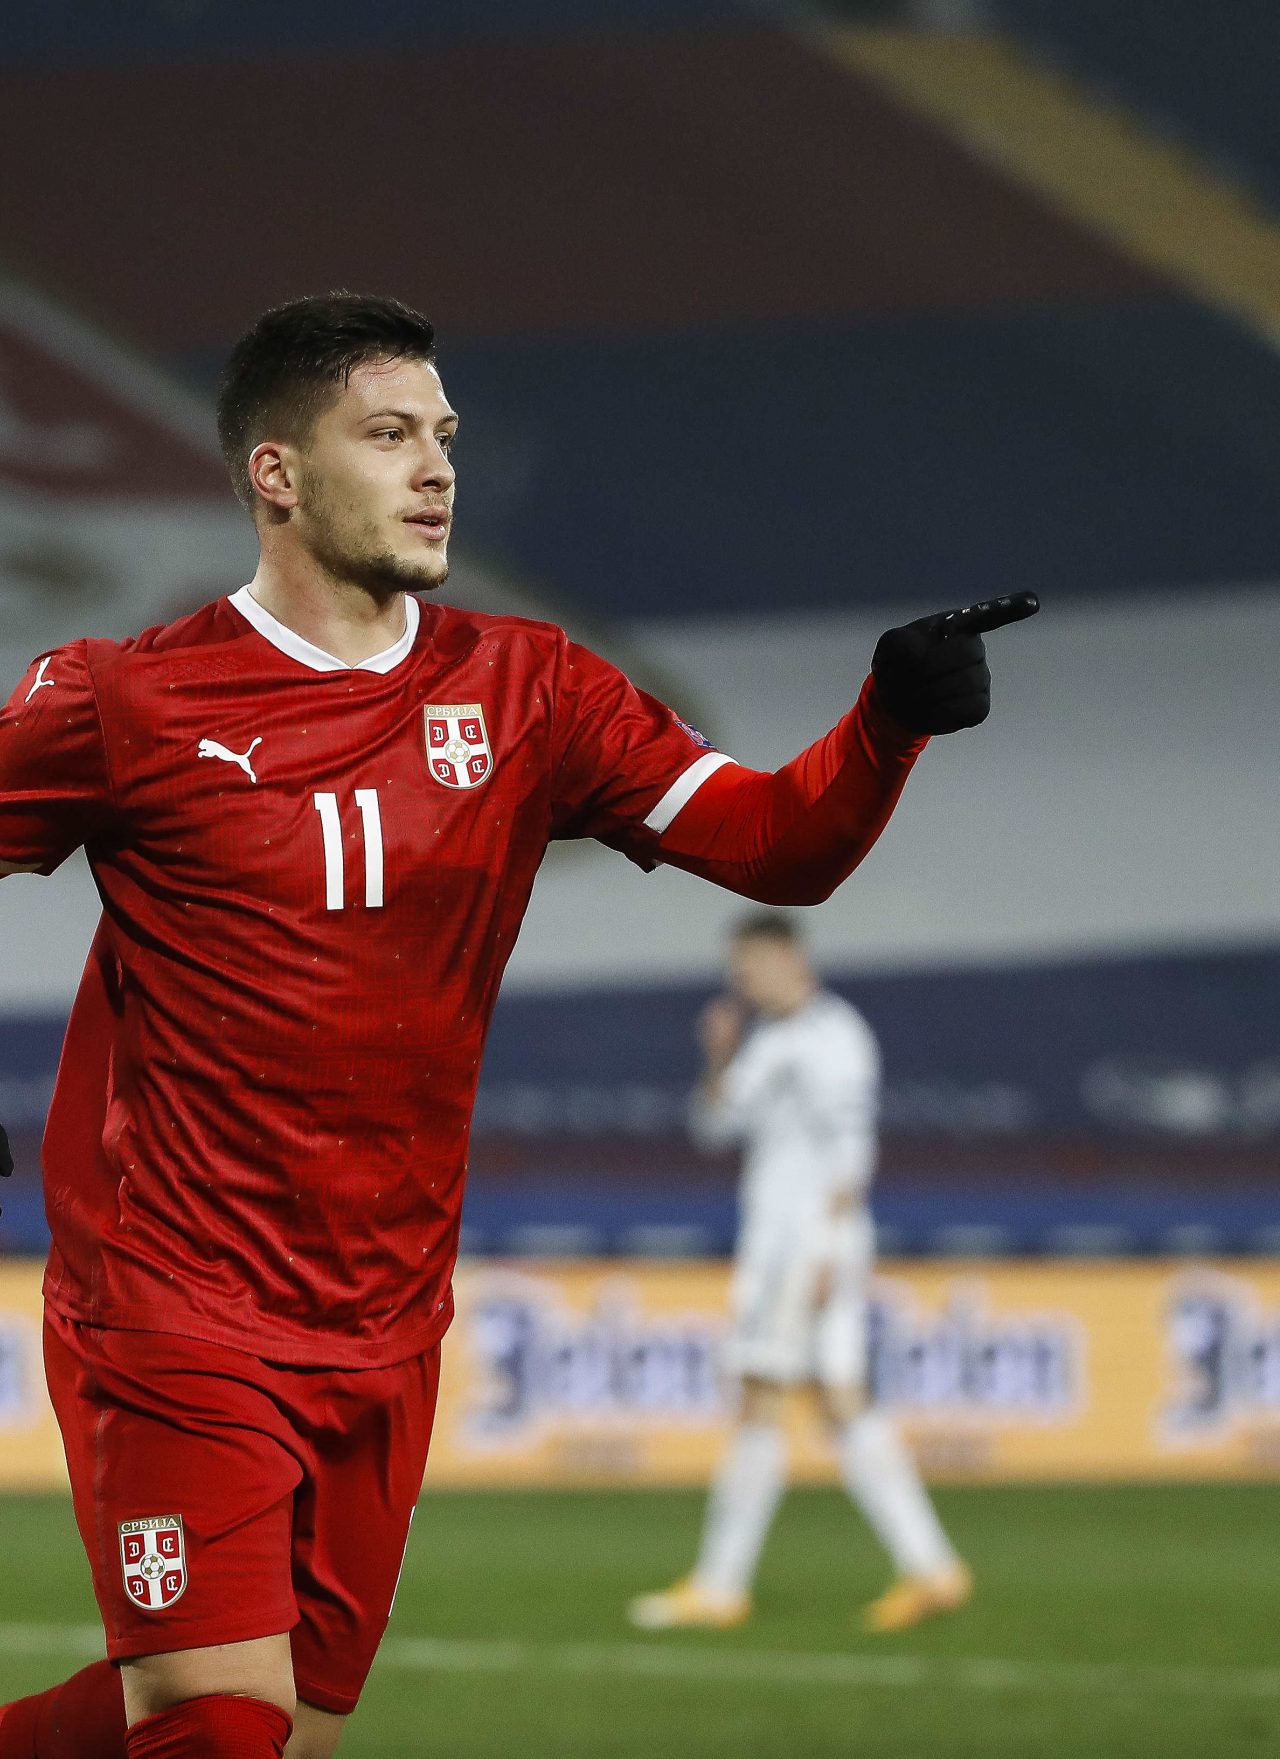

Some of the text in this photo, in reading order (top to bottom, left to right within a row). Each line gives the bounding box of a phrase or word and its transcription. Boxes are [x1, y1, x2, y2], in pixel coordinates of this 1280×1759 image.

[425, 705, 479, 717] СРБИЈА
[313, 788, 384, 910] 11
[120, 1517, 178, 1533] СРБИЈА
